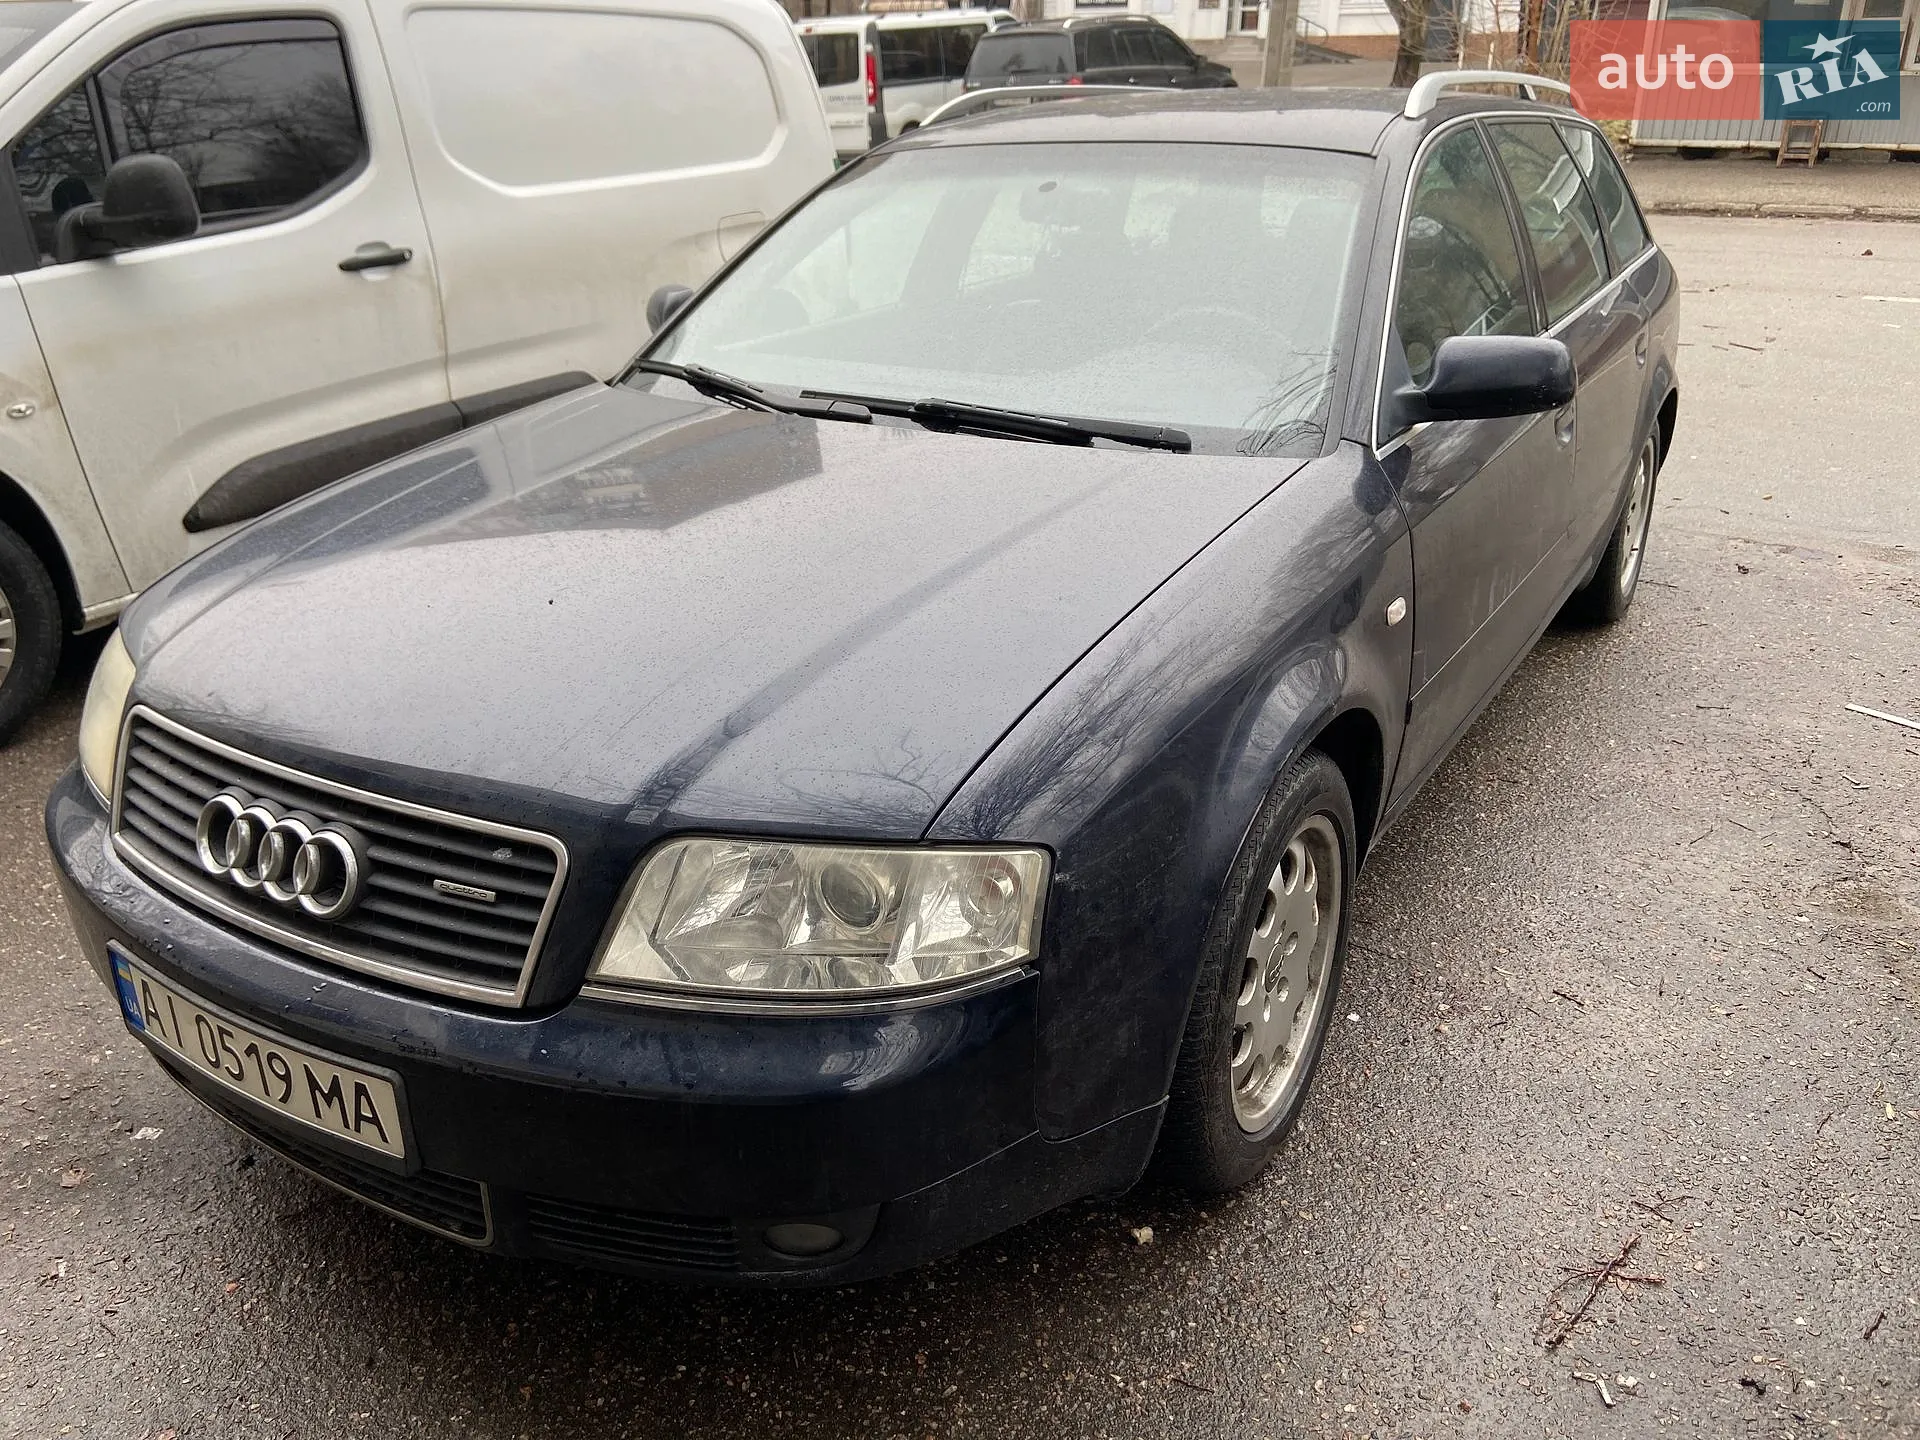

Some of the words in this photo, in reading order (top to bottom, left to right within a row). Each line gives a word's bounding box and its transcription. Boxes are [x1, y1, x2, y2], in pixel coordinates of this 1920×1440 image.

[124, 995, 142, 1019] UA
[140, 978, 184, 1049] AI
[195, 1013, 293, 1105] 0519
[303, 1062, 390, 1144] MA
